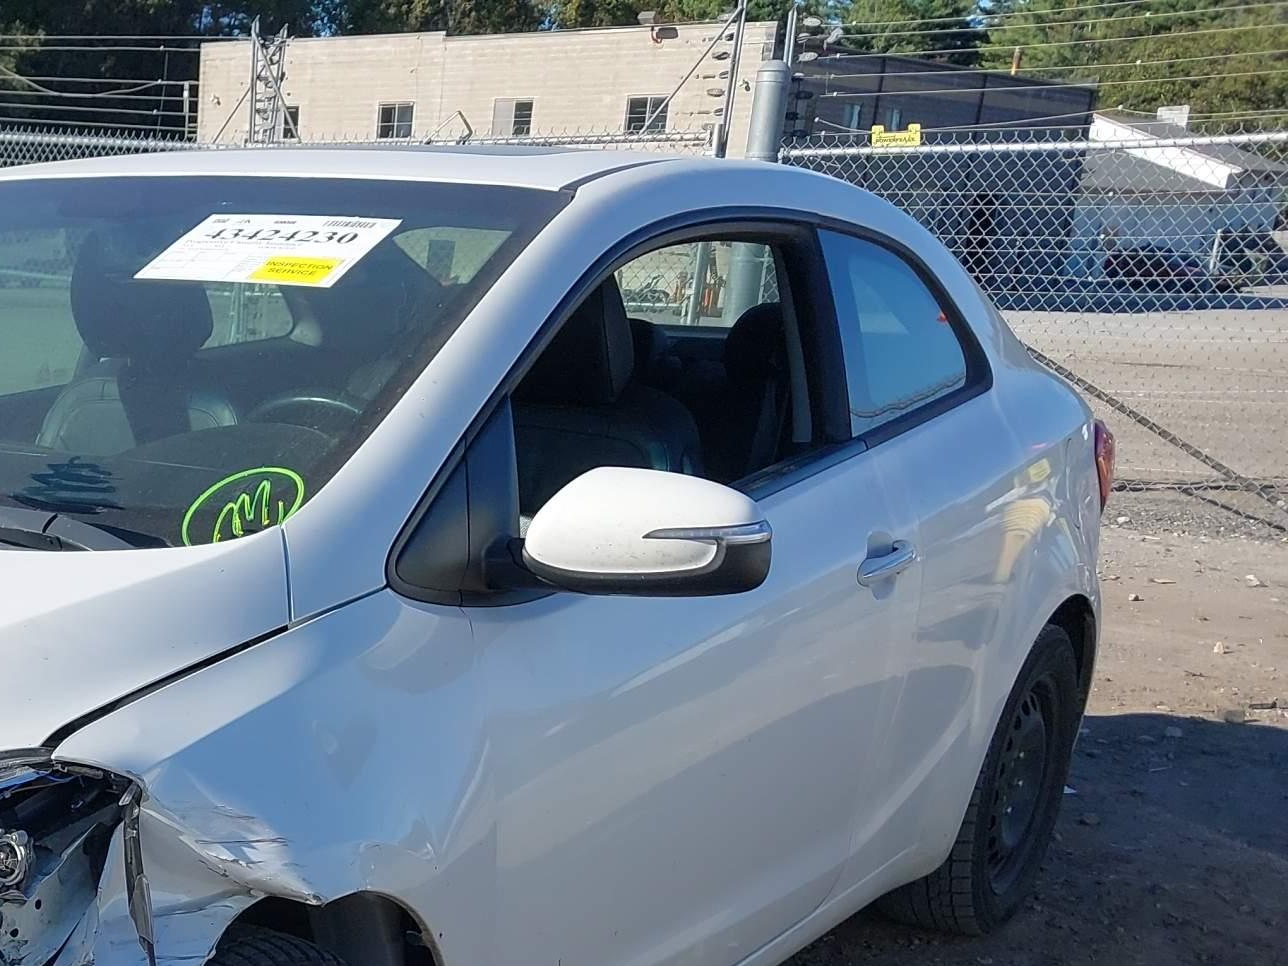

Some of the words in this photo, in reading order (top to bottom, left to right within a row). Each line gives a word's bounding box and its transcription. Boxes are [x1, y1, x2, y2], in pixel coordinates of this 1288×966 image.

[204, 227, 359, 245] 43424230
[266, 260, 334, 270] INSPECTION
[267, 267, 318, 276] SERVICE
